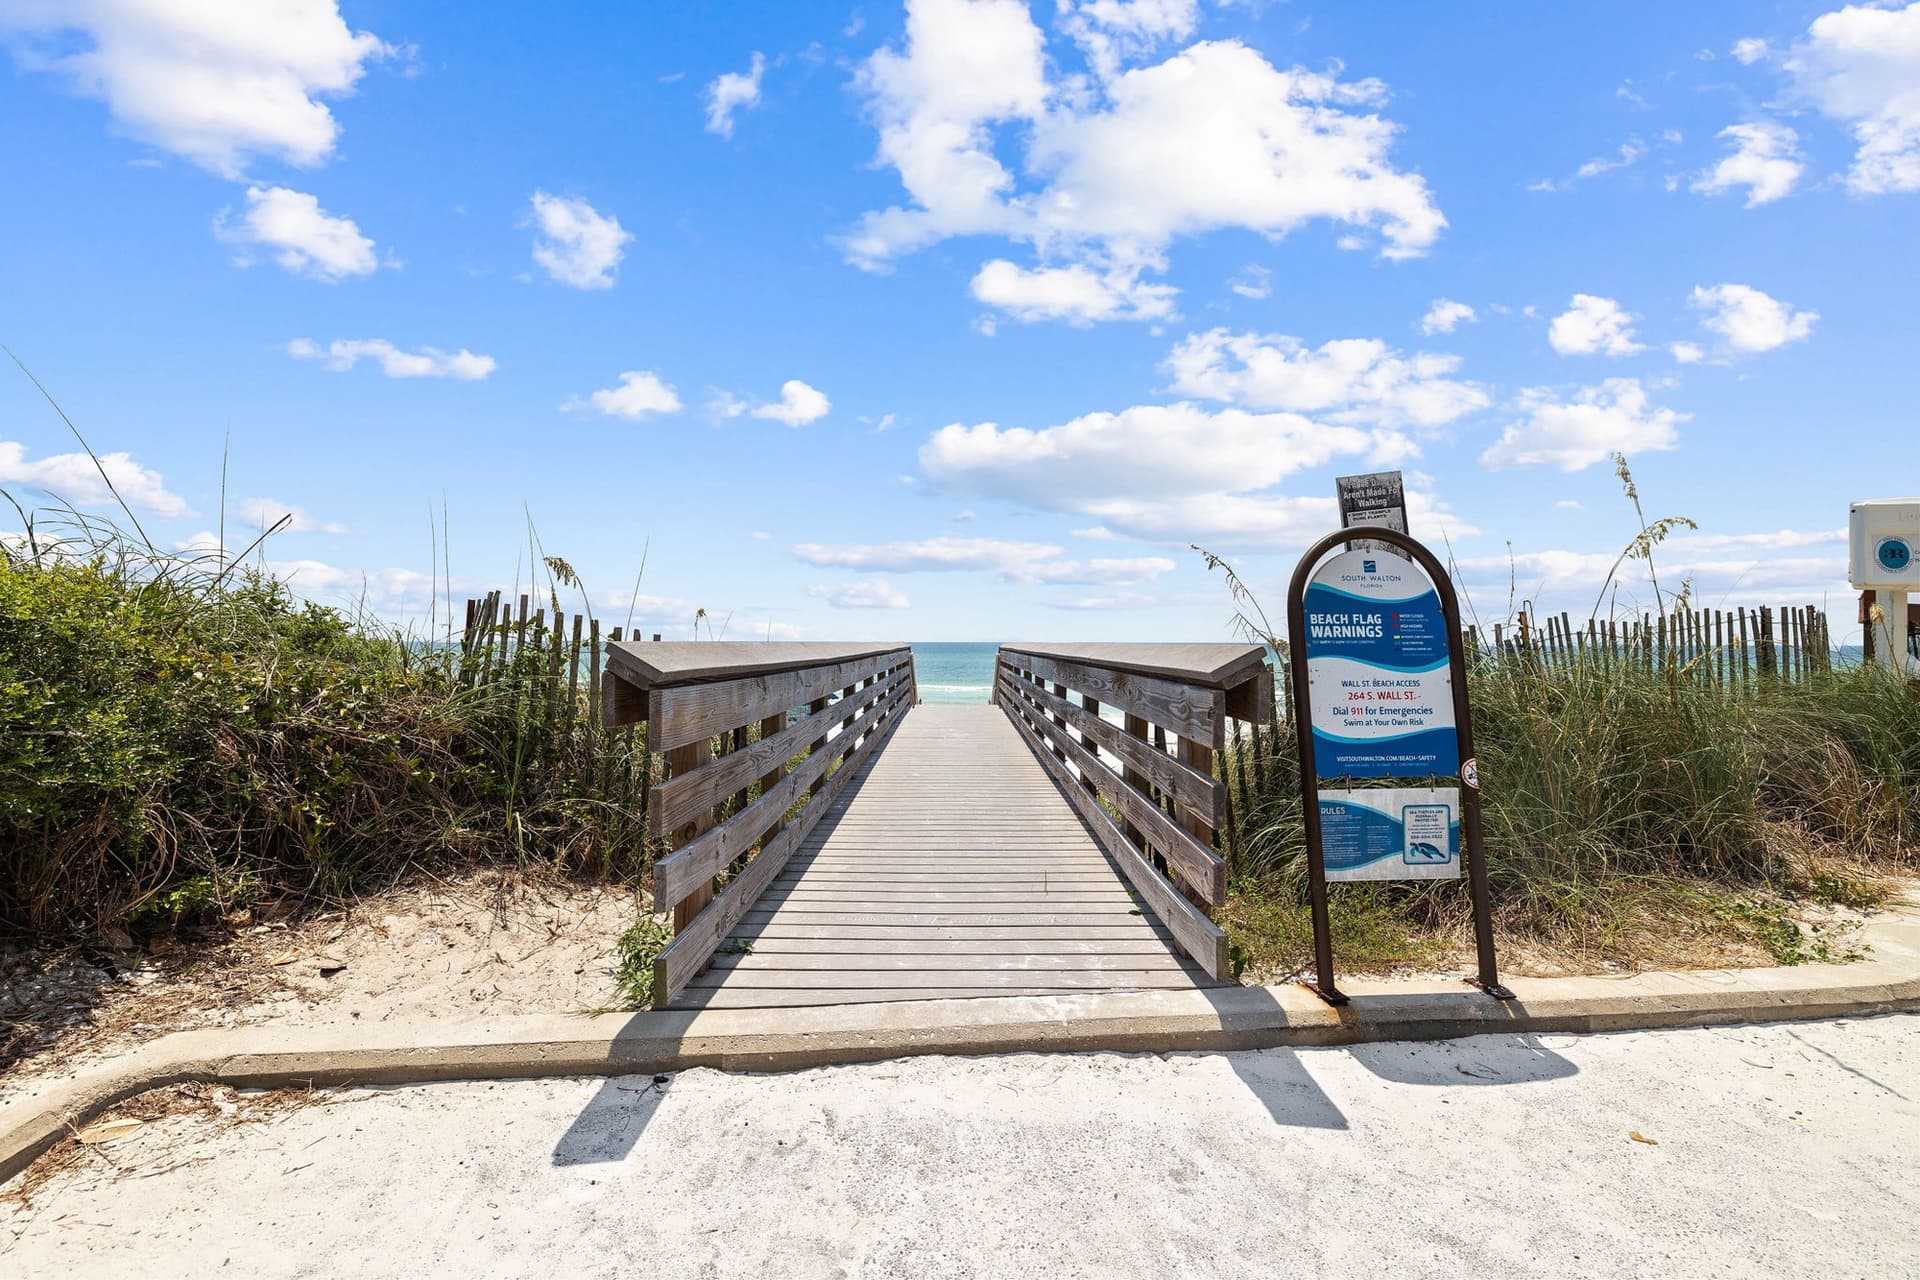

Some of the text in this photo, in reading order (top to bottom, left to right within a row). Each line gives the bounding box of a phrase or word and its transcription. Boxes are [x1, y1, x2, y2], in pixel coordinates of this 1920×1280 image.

[1358, 498, 1387, 507] Walking
[1310, 613, 1382, 624] BEACH FLAG
[1311, 625, 1383, 638] WARNINGS
[1348, 691, 1416, 700] 264 S. WALL ST.
[1333, 706, 1433, 717] Dial 911 for Emergencies
[1391, 718, 1408, 726] Own
[1409, 718, 1424, 726] Risk
[1321, 807, 1346, 815] RULES
